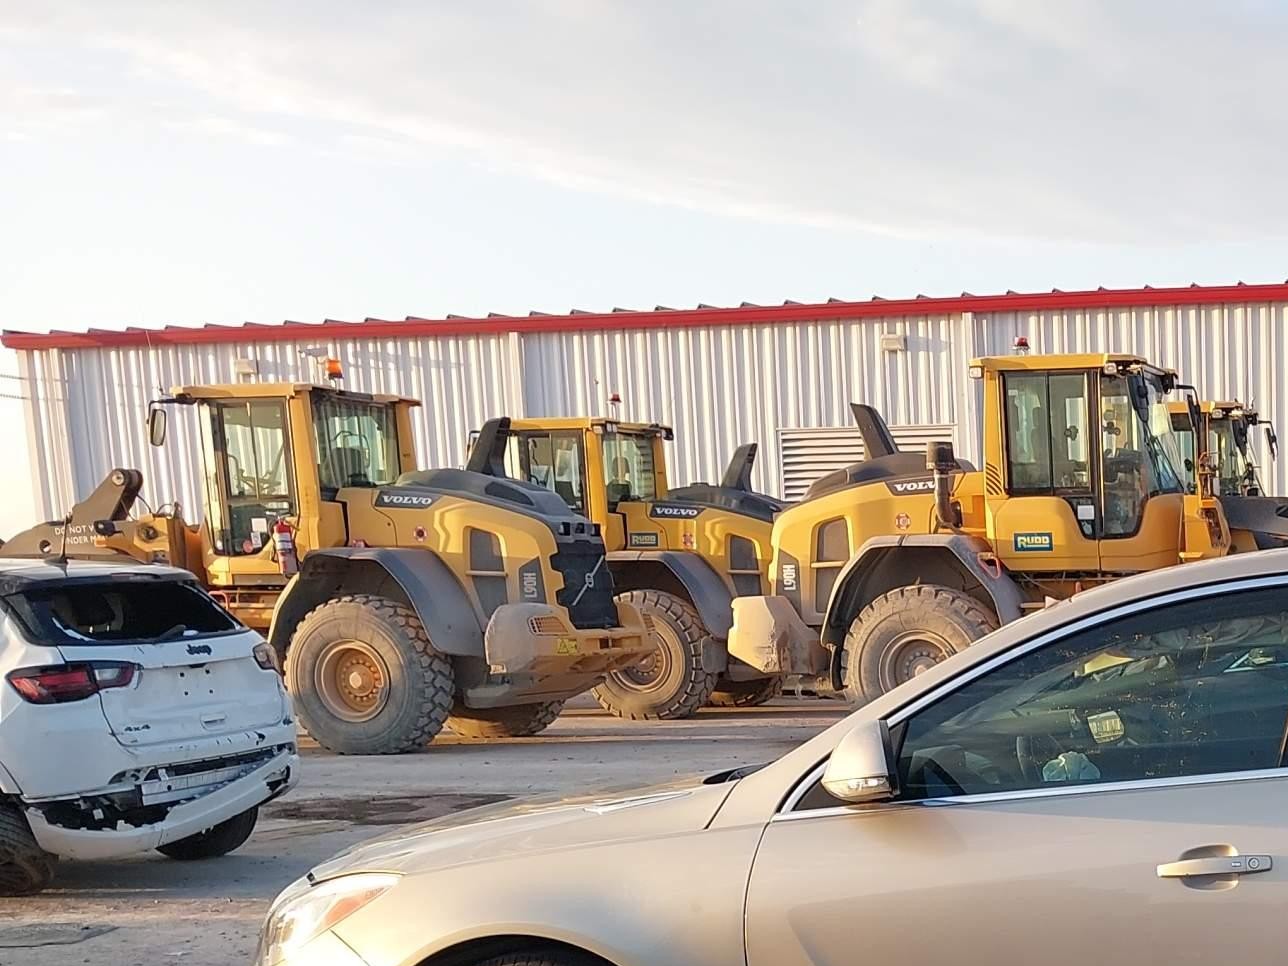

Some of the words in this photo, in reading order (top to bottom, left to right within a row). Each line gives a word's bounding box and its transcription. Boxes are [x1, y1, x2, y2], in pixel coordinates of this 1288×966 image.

[894, 481, 936, 492] VOLV
[382, 494, 433, 506] VOLVO
[655, 507, 698, 516] VOLVO
[69, 525, 87, 534] NOT
[1017, 536, 1050, 548] RUDD
[784, 564, 796, 591] L90H
[523, 572, 537, 599] L90H
